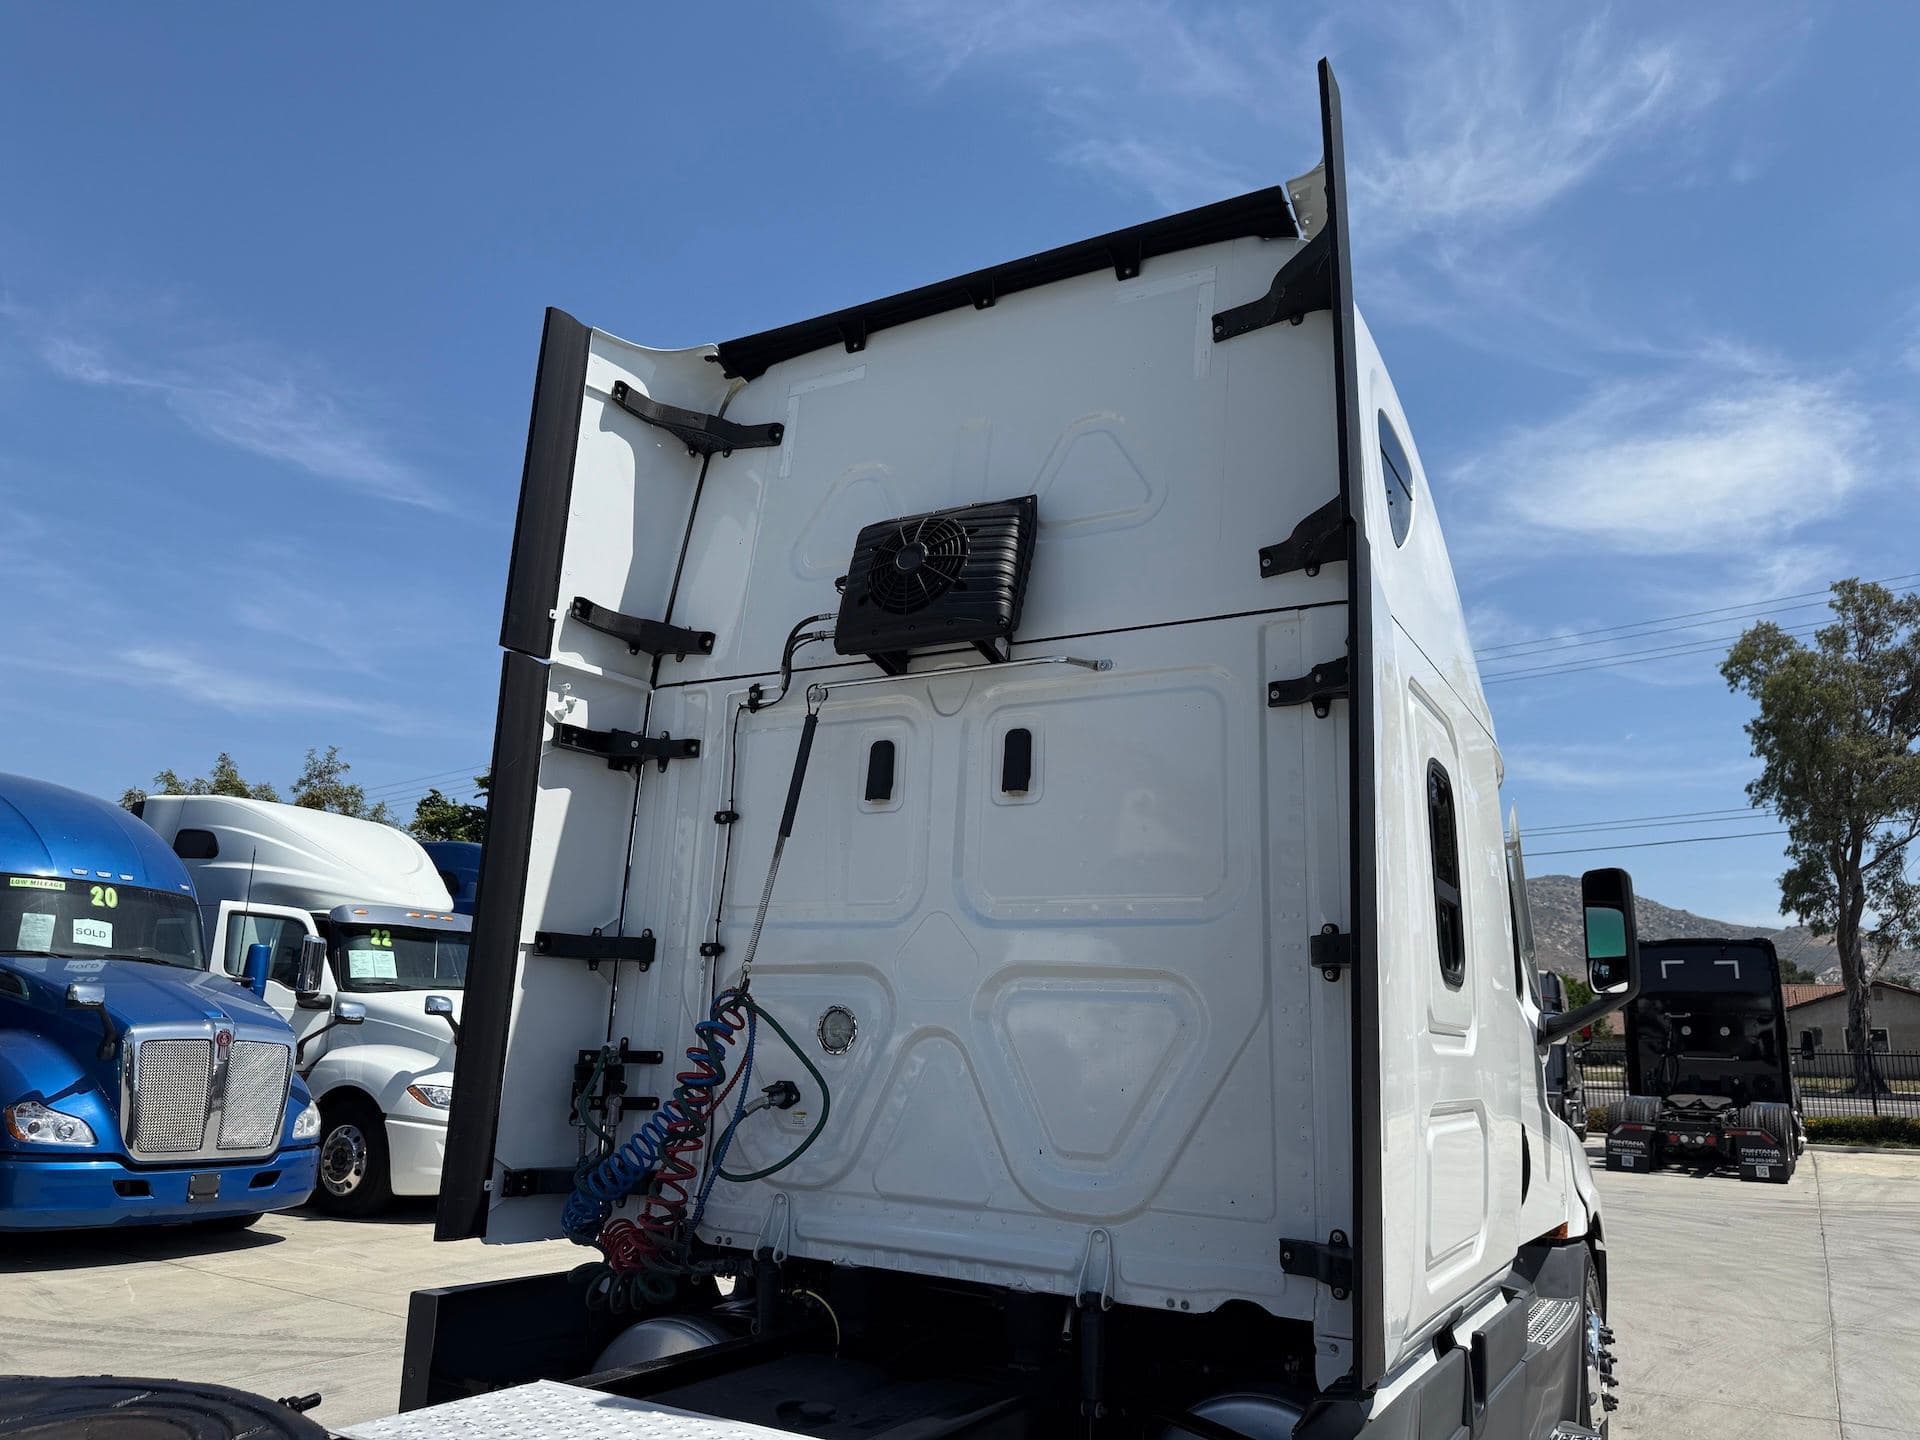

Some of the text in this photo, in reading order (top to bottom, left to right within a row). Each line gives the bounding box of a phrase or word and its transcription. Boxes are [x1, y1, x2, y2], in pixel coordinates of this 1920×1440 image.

[30, 879, 64, 888] MILEAGE
[90, 885, 119, 909] 20
[75, 927, 106, 939] SOLD
[370, 928, 393, 948] 22
